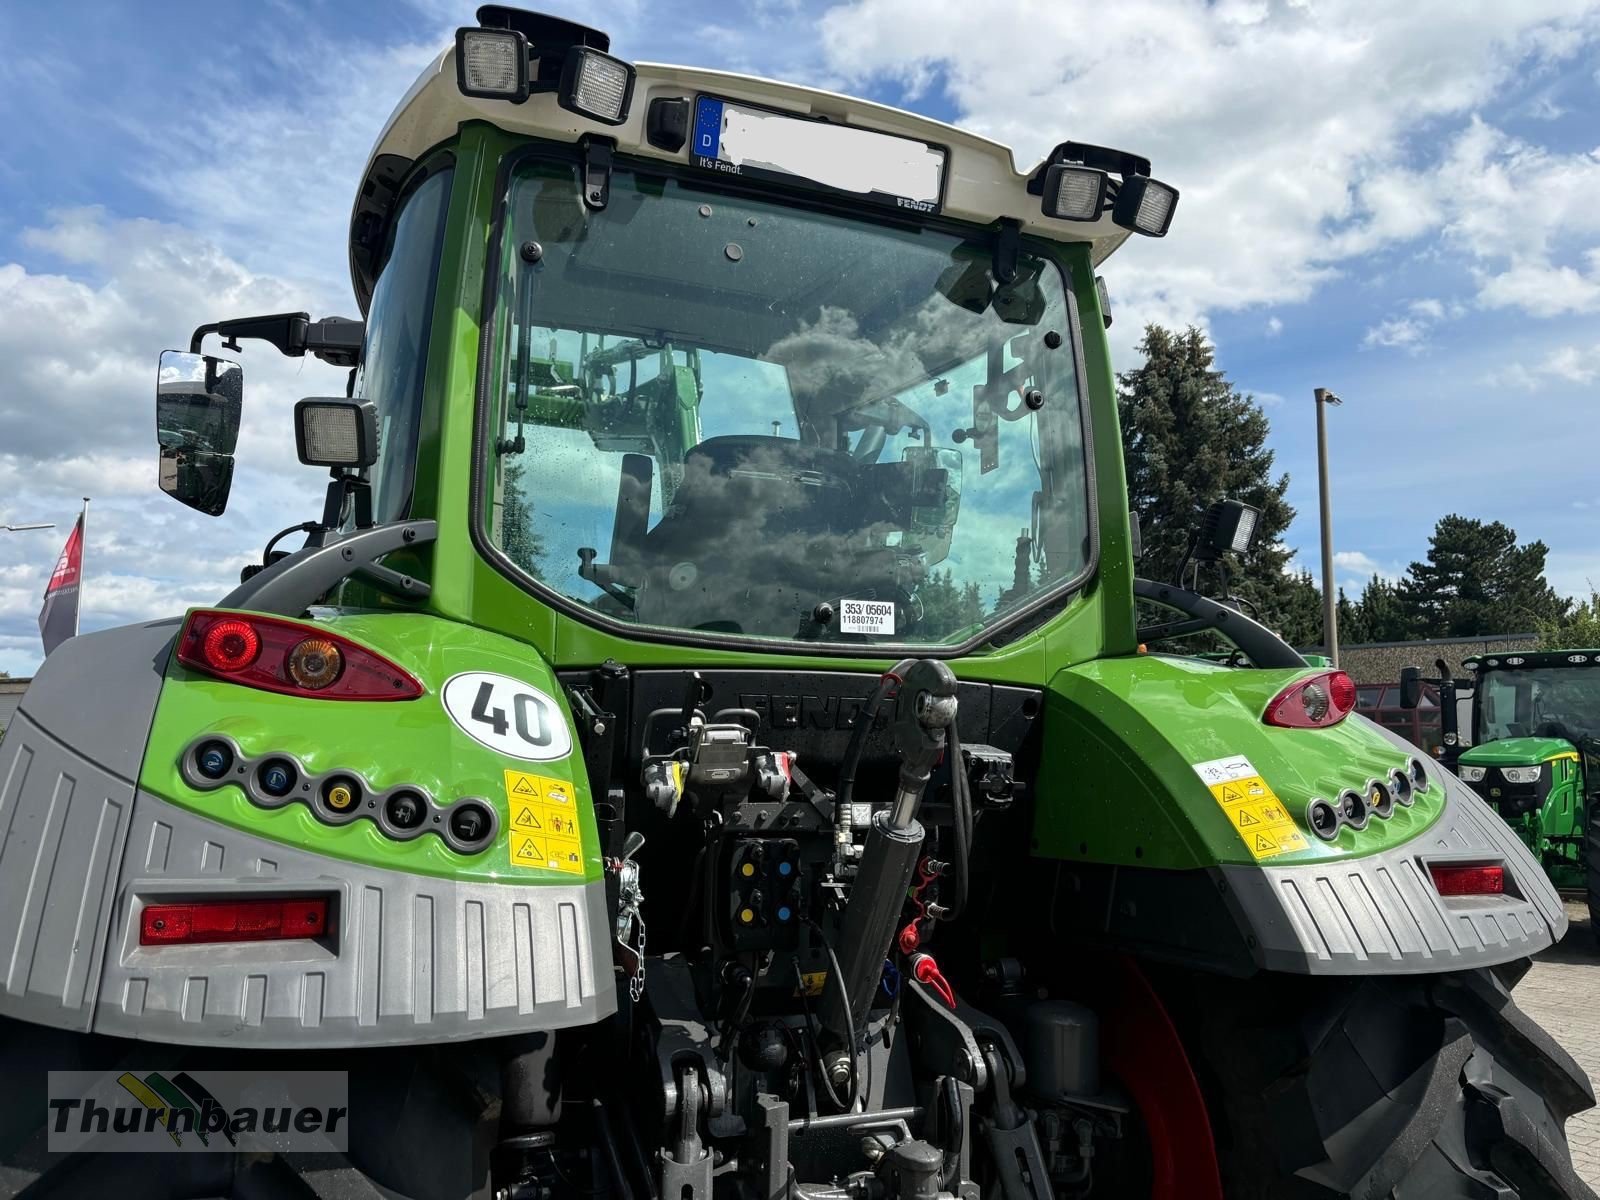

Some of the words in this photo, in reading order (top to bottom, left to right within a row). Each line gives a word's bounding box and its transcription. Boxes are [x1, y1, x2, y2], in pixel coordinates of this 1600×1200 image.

[702, 134, 712, 147] D
[699, 156, 713, 169] It's
[714, 160, 743, 175] Fendt.
[896, 197, 935, 213] FENDT
[842, 615, 884, 625] 118807974
[471, 681, 552, 747] 40
